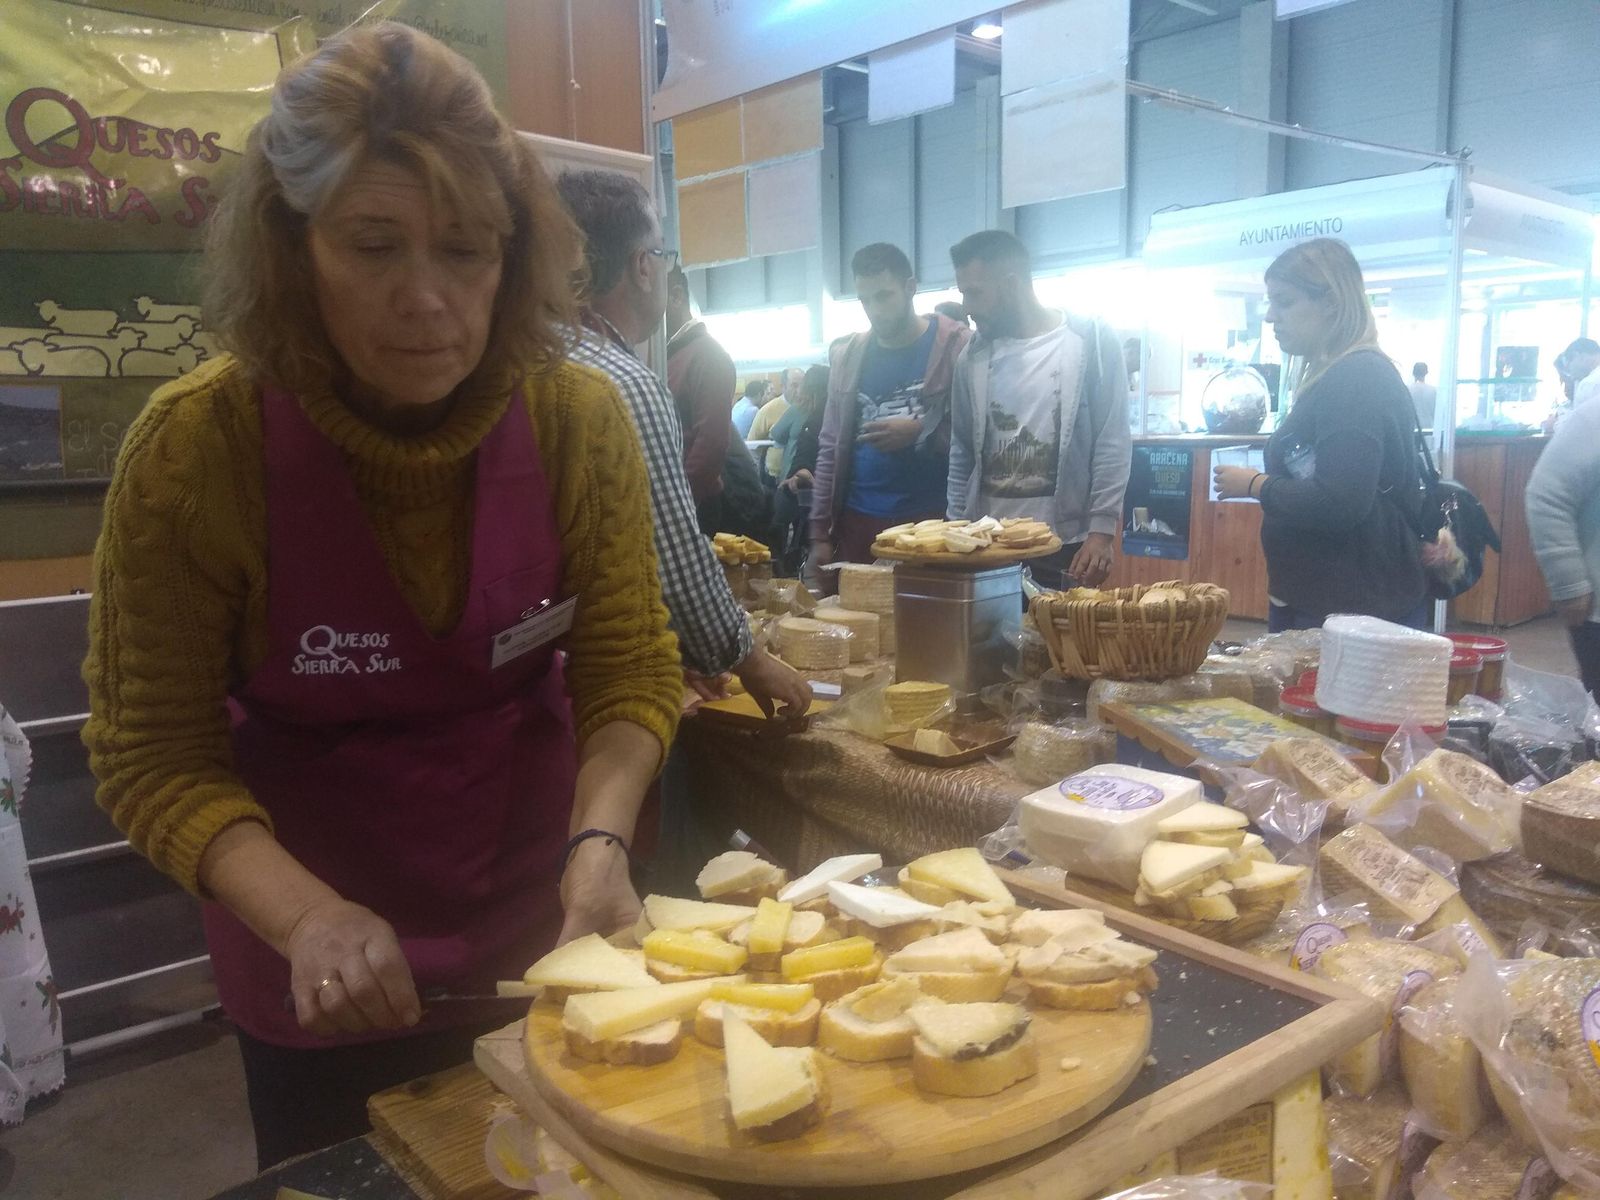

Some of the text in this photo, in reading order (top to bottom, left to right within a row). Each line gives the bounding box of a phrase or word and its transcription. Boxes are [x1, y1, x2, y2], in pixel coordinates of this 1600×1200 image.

[1239, 216, 1343, 246] AYUNTAMIENTO
[300, 624, 391, 661] QUESOS
[291, 653, 402, 674] SIERRA SUR
